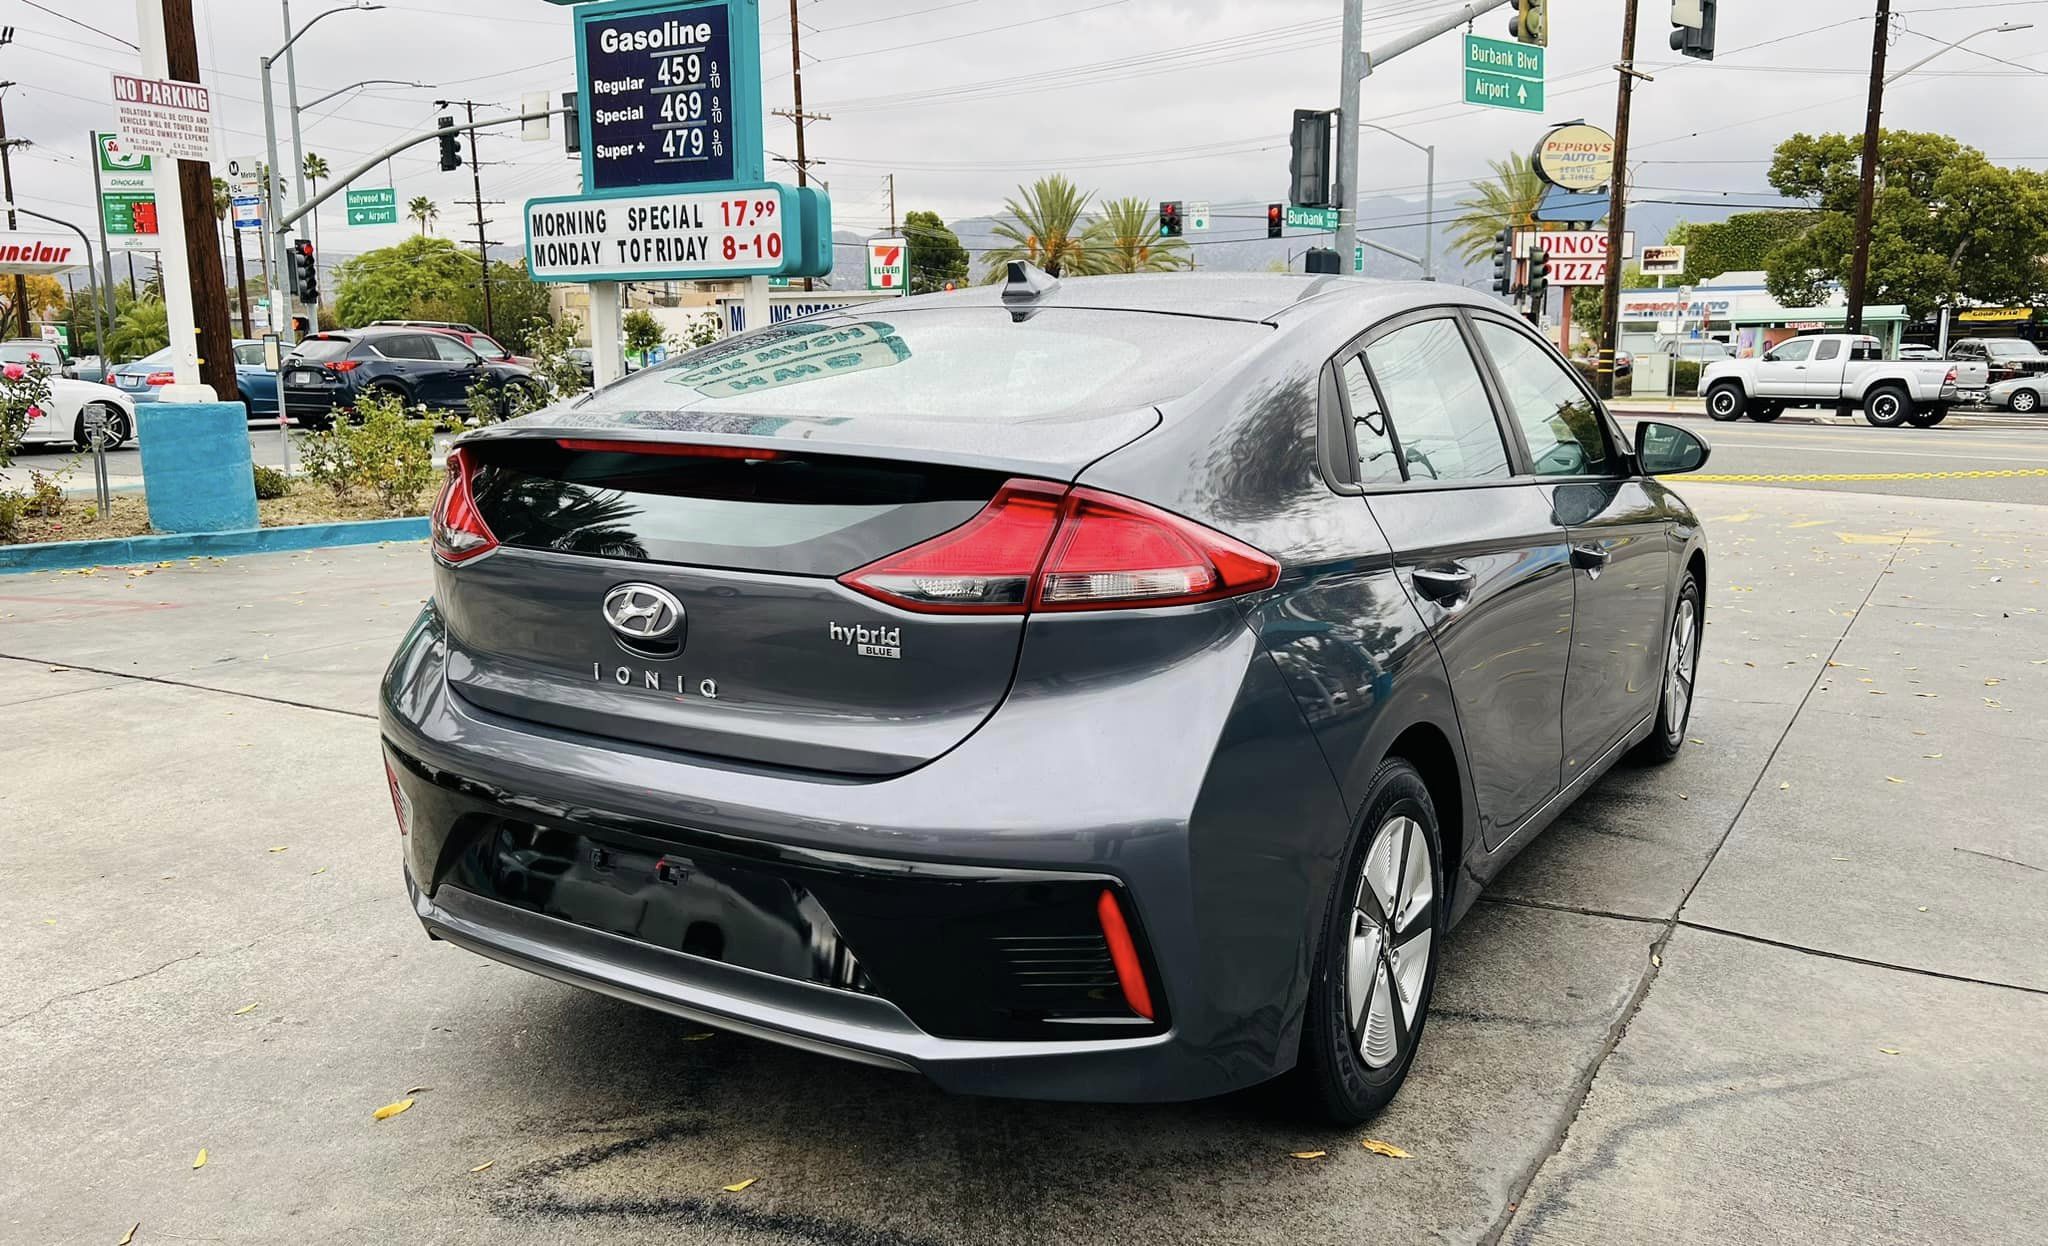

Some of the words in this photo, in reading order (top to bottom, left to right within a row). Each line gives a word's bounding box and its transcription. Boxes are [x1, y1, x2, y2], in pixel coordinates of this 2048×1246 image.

[600, 21, 712, 53] Gasoline
[1471, 43, 1513, 67] Burbank
[1517, 51, 1538, 71] Blvd
[657, 54, 701, 85] 459
[115, 78, 137, 101] NO
[141, 81, 208, 110] PARKING
[594, 77, 645, 95] Regular
[1475, 78, 1510, 100] Airport
[120, 107, 151, 118] VIOLATORS
[153, 111, 167, 120] WILL
[169, 113, 176, 121] BE
[178, 114, 194, 123] CITED
[196, 116, 208, 125] AND
[596, 105, 644, 126] Special
[660, 91, 701, 121] 469
[120, 116, 147, 126] VEHICLES
[149, 119, 162, 128] WILL
[164, 121, 171, 129] BE
[173, 123, 192, 132] TOWED
[194, 125, 209, 134] AWAY
[132, 126, 155, 137] VEHICLE
[184, 133, 209, 143] EXPENSE
[596, 144, 634, 160] Super
[637, 142, 645, 152] +
[662, 128, 704, 157] 479
[1561, 152, 1596, 162] AUTO
[230, 184, 242, 193] 154
[348, 193, 379, 206] Hollywood
[380, 191, 393, 204] Way
[368, 210, 390, 223] Airport
[532, 208, 607, 238] MORNING
[628, 204, 704, 232] SPECIAL
[721, 200, 776, 227] 17.99
[1288, 209, 1323, 226] Burbank
[0, 241, 71, 263] inclair
[534, 241, 601, 268] MONDAY
[722, 232, 782, 261] 8-10
[1539, 234, 1608, 254] DINO'S
[829, 621, 900, 647] hybrid
[864, 646, 894, 657] BLUE
[593, 662, 718, 699] IONIQ
